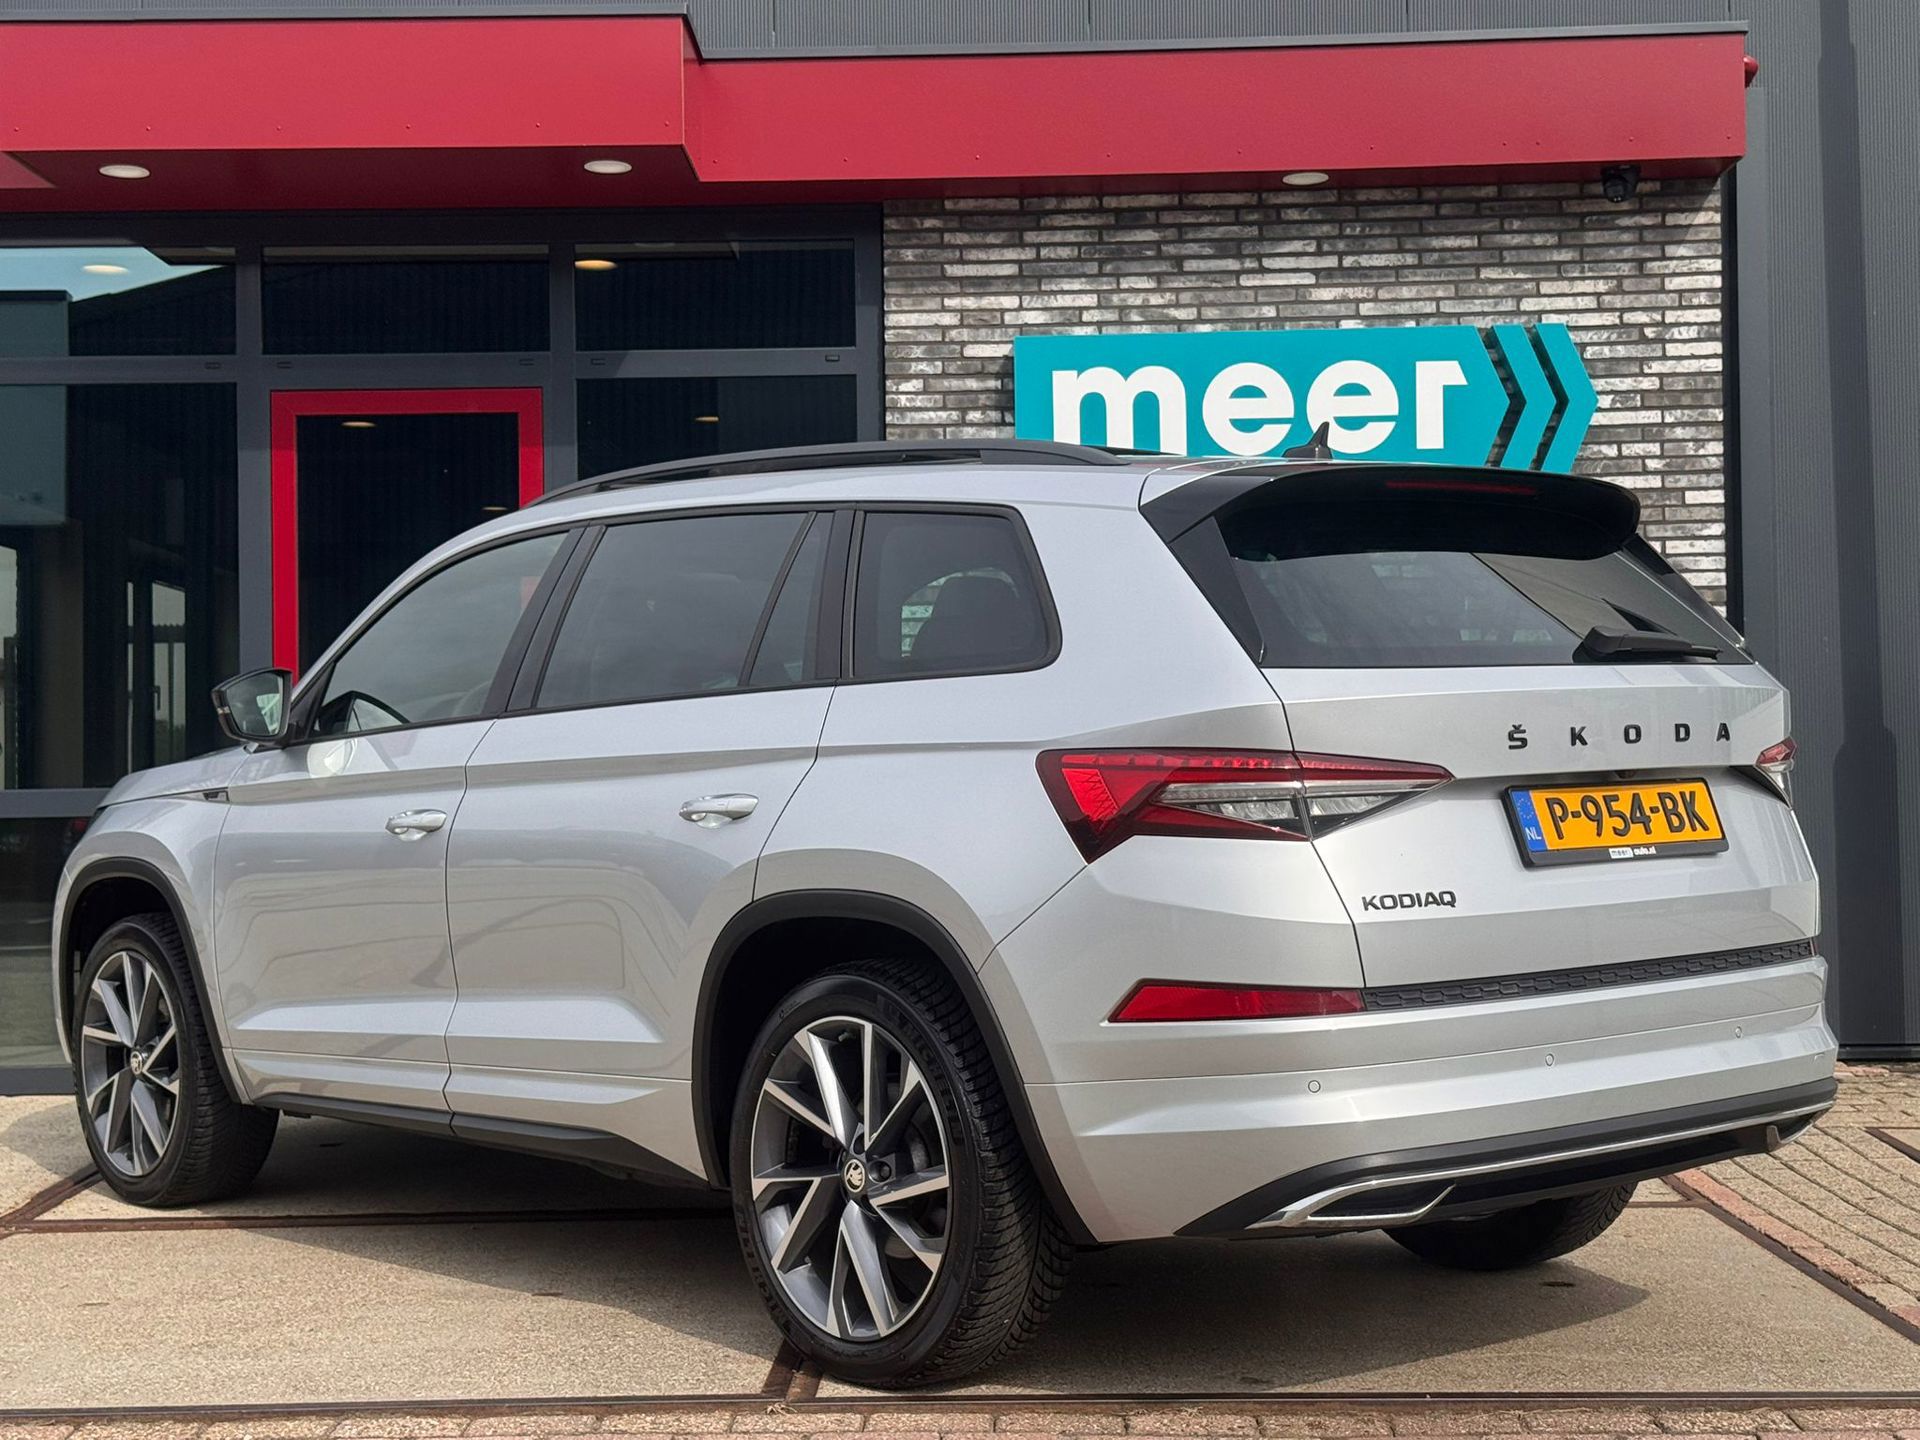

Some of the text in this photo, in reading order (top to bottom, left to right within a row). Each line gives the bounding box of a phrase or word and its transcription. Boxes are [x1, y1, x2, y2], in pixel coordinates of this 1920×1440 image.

[1052, 359, 1468, 456] meer
[1507, 721, 1731, 750] ŠKODA
[1545, 790, 1710, 841] P-954-BK
[1525, 827, 1542, 841] NL
[1361, 890, 1457, 911] KODIAQ
